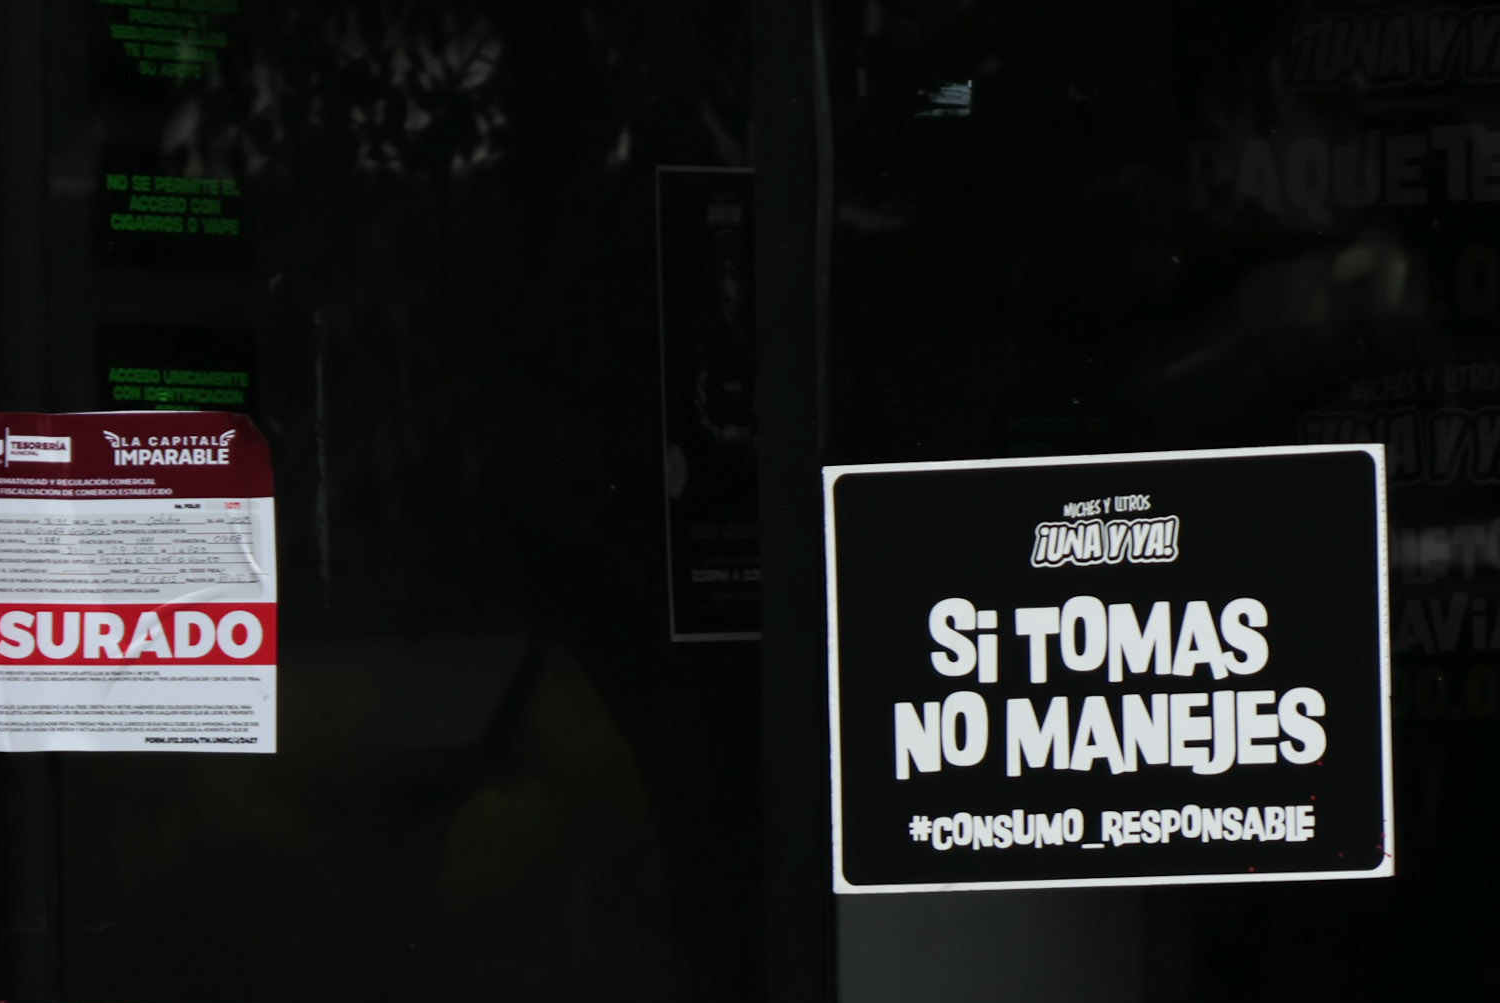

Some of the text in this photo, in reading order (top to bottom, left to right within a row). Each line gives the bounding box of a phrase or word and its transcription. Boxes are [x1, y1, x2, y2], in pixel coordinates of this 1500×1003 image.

[106, 174, 241, 196] NO SE PERMITE EL
[129, 195, 221, 214] ACCESO CON
[110, 213, 184, 232] CIGARROS
[203, 218, 240, 235] VAPE
[109, 368, 161, 383] ACCESO
[112, 385, 141, 401] CON
[121, 436, 219, 447] LA CAPITAL
[114, 448, 230, 466] IMPARABLE
[1063, 494, 1152, 518] MICHES Y LITROS
[1034, 519, 1175, 563] ¡UNA Y YA!
[1015, 596, 1269, 684] TOMAS
[894, 687, 1327, 780] NO MANEJES
[909, 804, 1316, 850] #CONSUMO_RESPONSABLE
